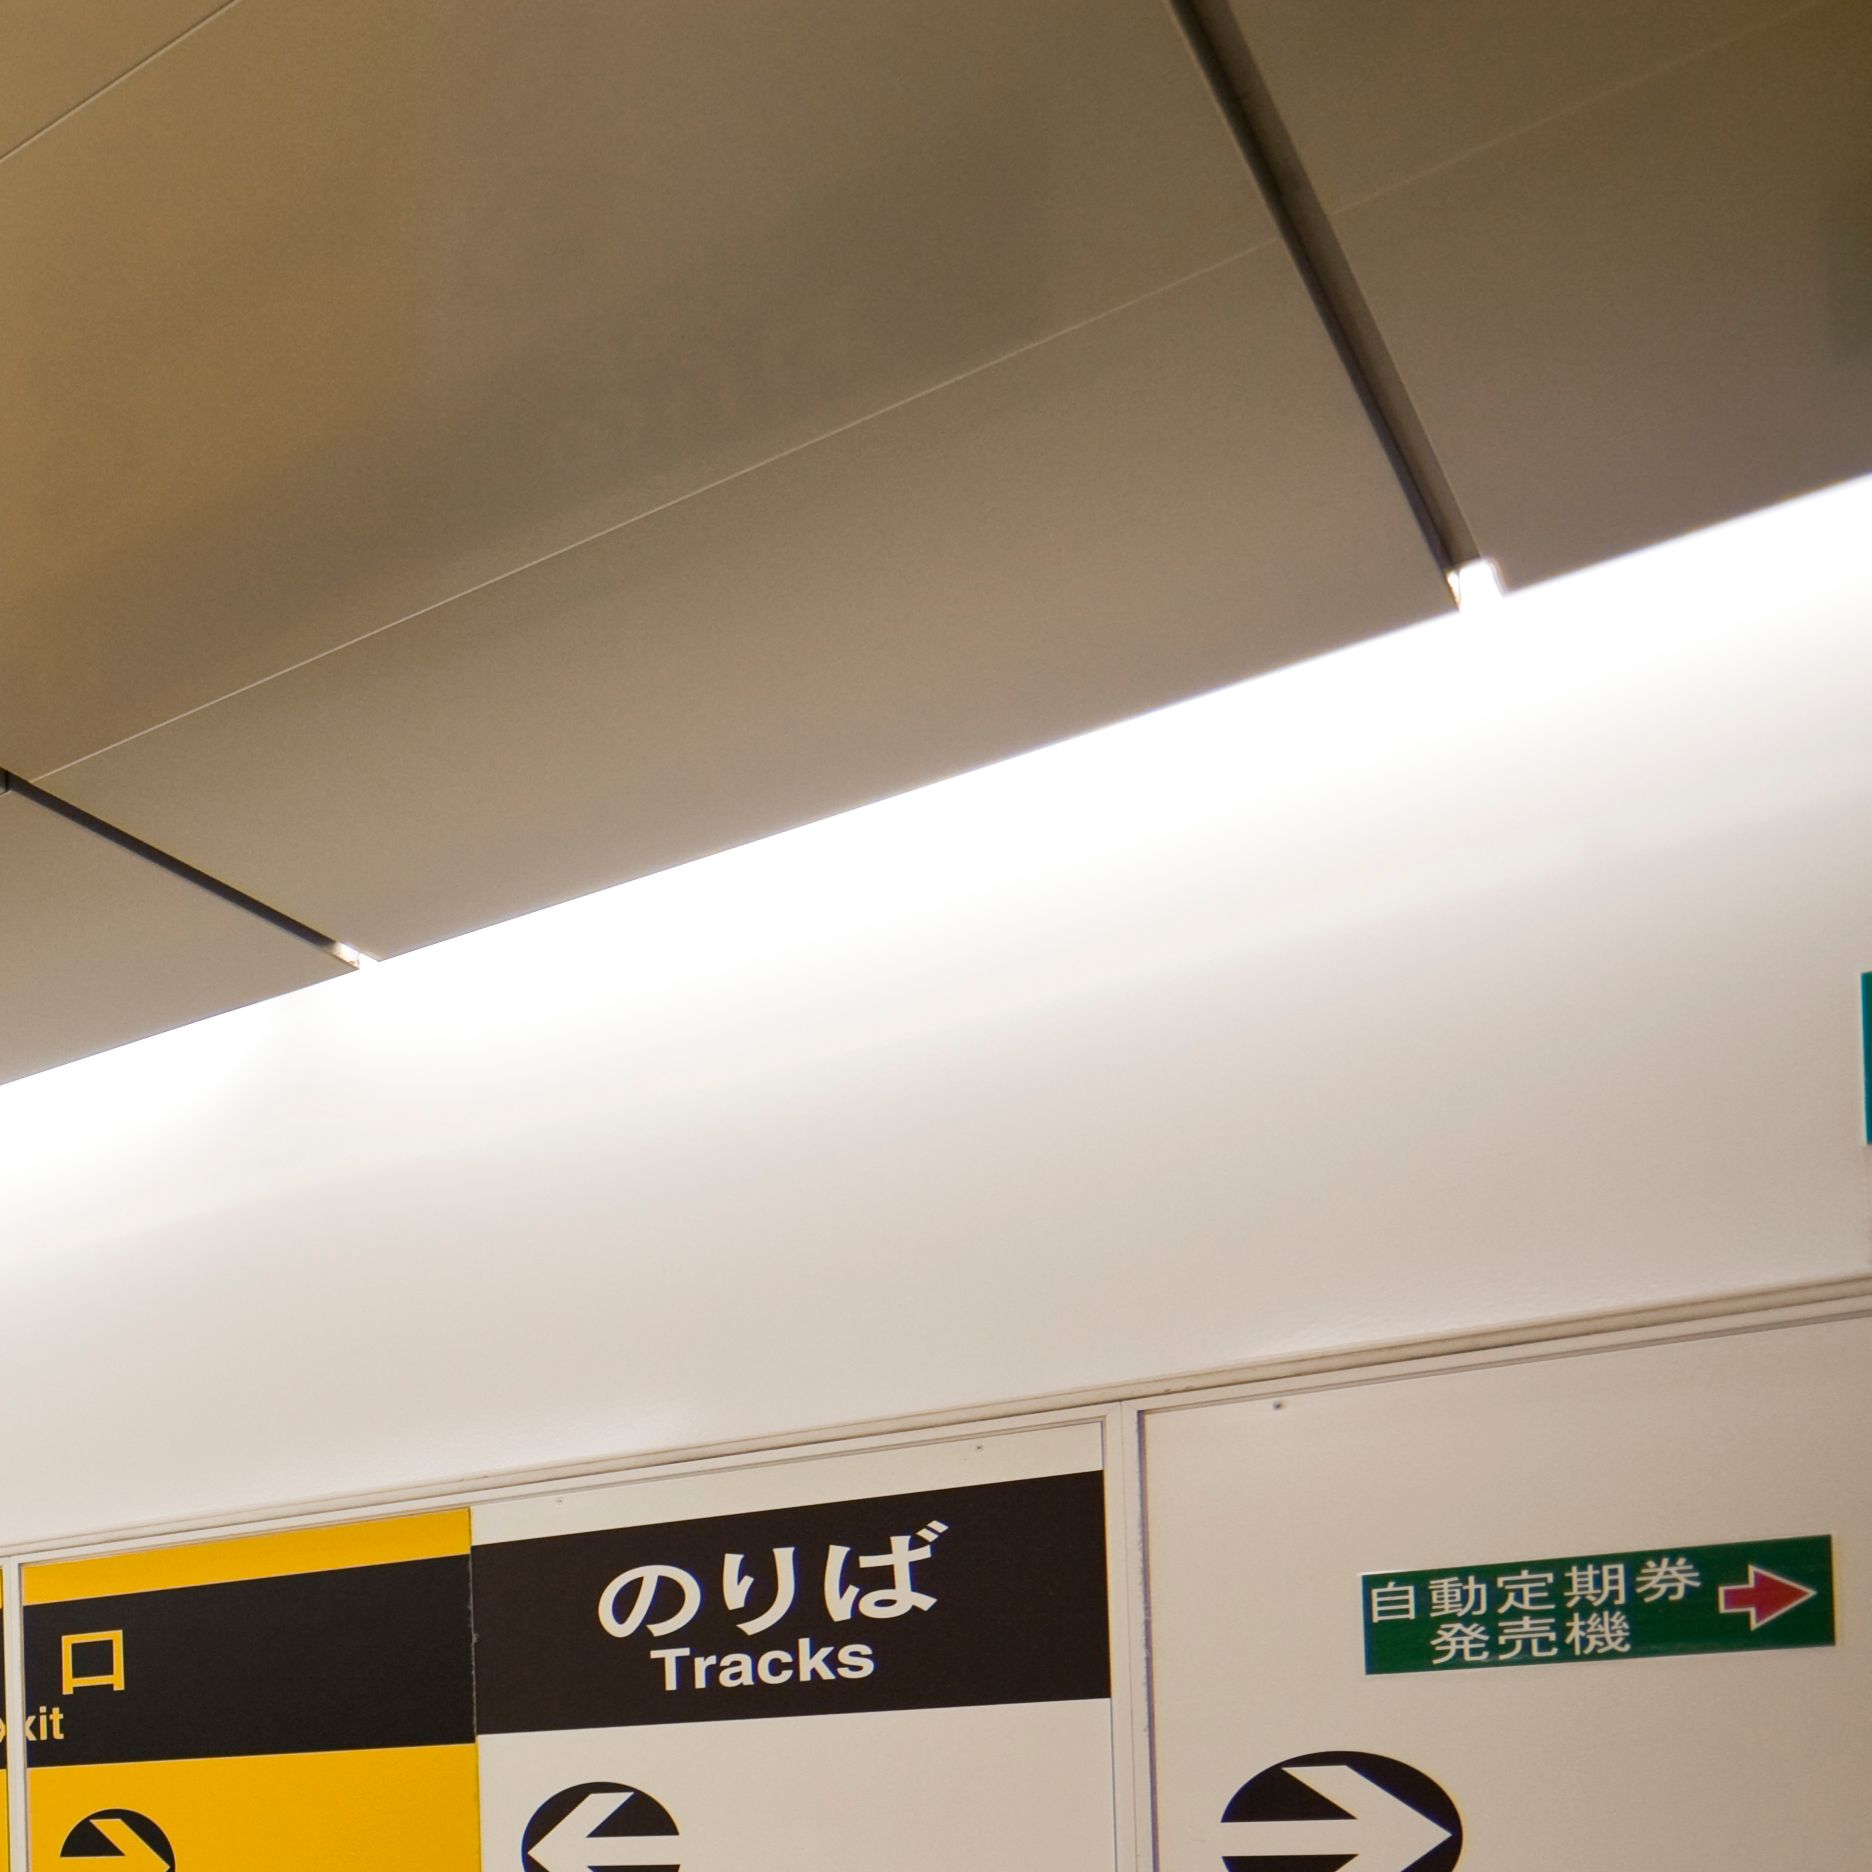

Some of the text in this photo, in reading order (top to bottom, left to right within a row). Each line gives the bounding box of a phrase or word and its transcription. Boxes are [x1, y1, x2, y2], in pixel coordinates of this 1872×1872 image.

[598, 1519, 949, 1638] のりば
[1370, 1556, 1702, 1623] 自動定期券
[650, 1637, 875, 1691] Tracks
[1430, 1610, 1632, 1666] 発売機
